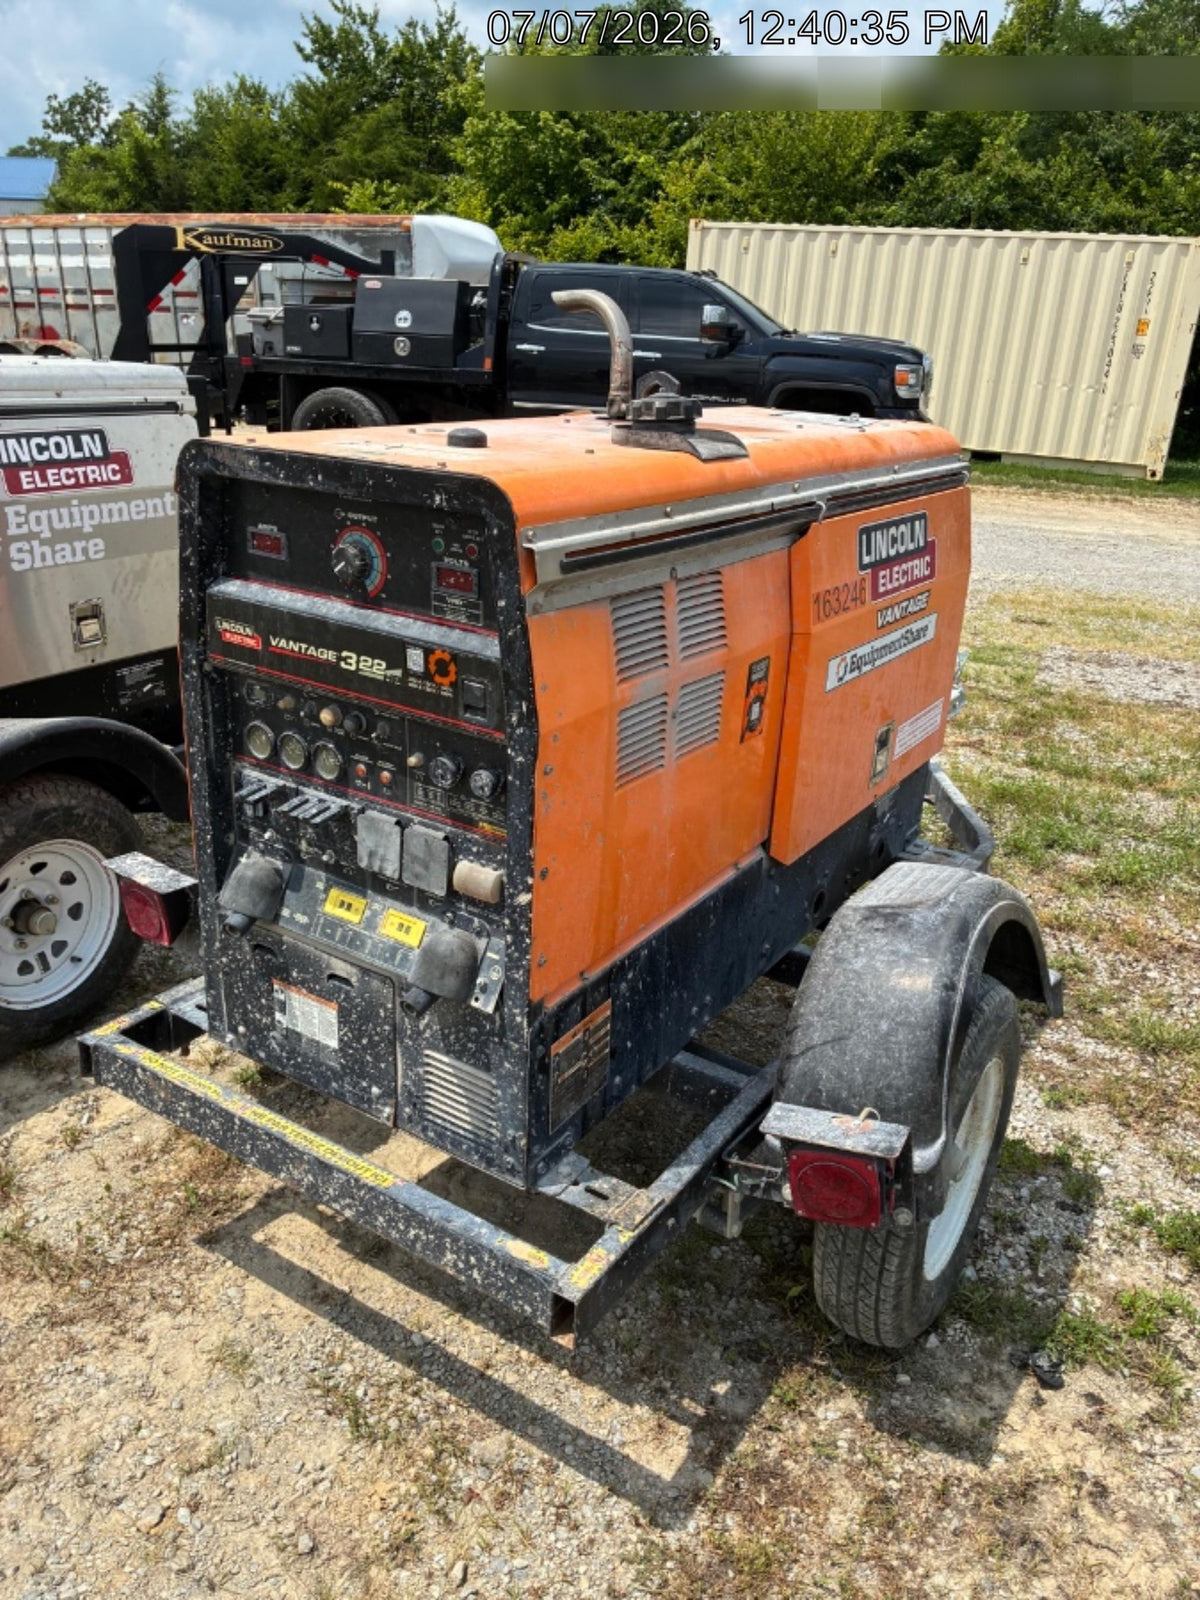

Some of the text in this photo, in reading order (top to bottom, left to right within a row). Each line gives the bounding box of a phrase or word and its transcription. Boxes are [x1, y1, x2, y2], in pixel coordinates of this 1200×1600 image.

[172, 225, 274, 253] Kaufman
[0, 433, 104, 464] INCOLN
[19, 463, 122, 490] ELECTRIC
[4, 491, 178, 539] Equipment
[9, 537, 106, 572] Share
[862, 518, 926, 565] LINCOLN
[878, 555, 931, 593] ELECTRIC
[812, 577, 867, 625] 163246
[876, 590, 931, 630] VANTAGE
[269, 635, 387, 676] VANTAGE 322
[849, 623, 930, 675] EquipmentShare
